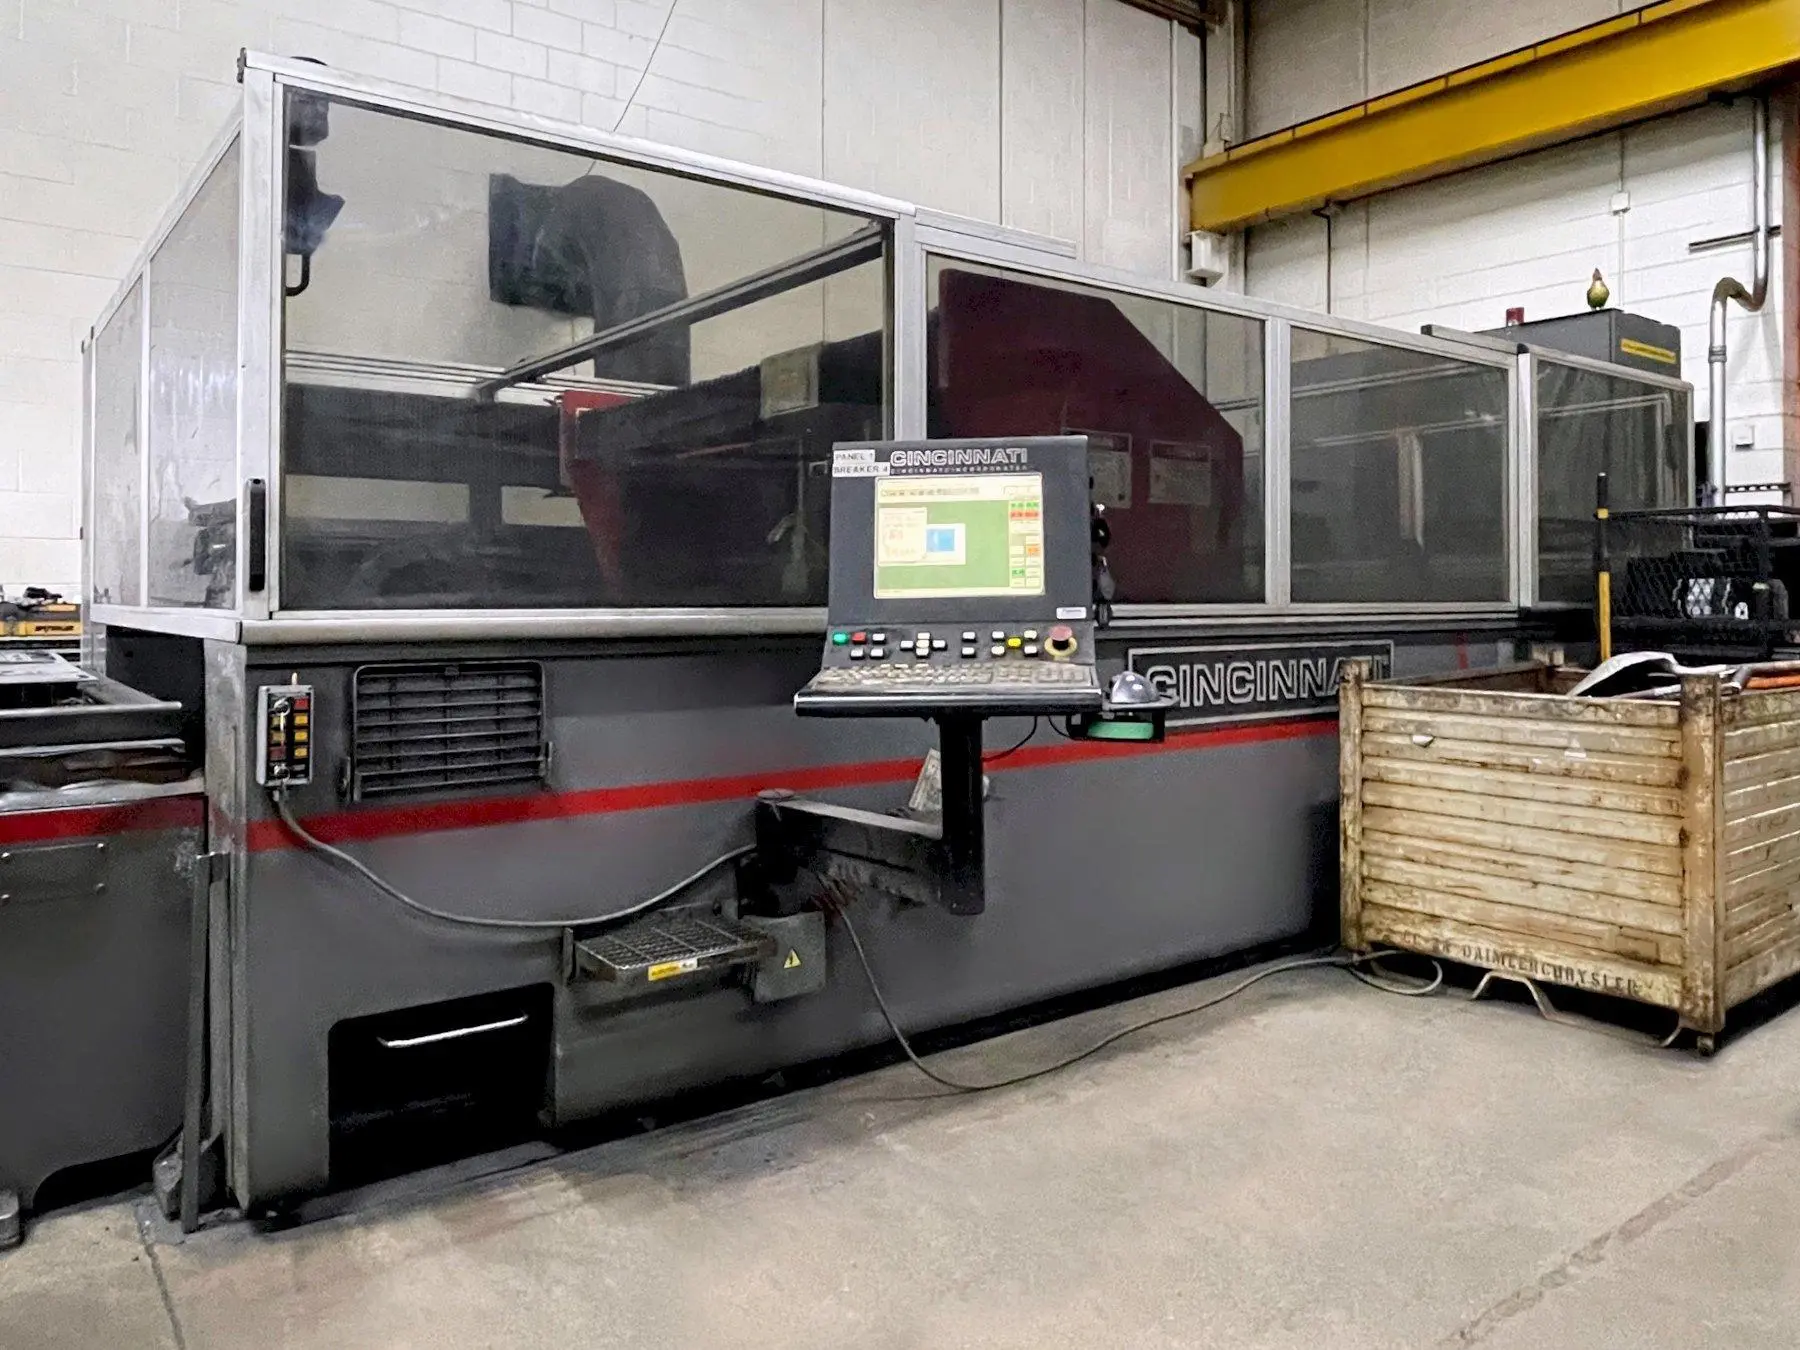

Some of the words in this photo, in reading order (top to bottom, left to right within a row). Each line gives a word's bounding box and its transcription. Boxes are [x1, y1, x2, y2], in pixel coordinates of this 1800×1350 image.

[835, 452, 865, 461] PANEL
[890, 448, 1027, 467] CINCINNATI
[833, 465, 879, 474] BREAKER
